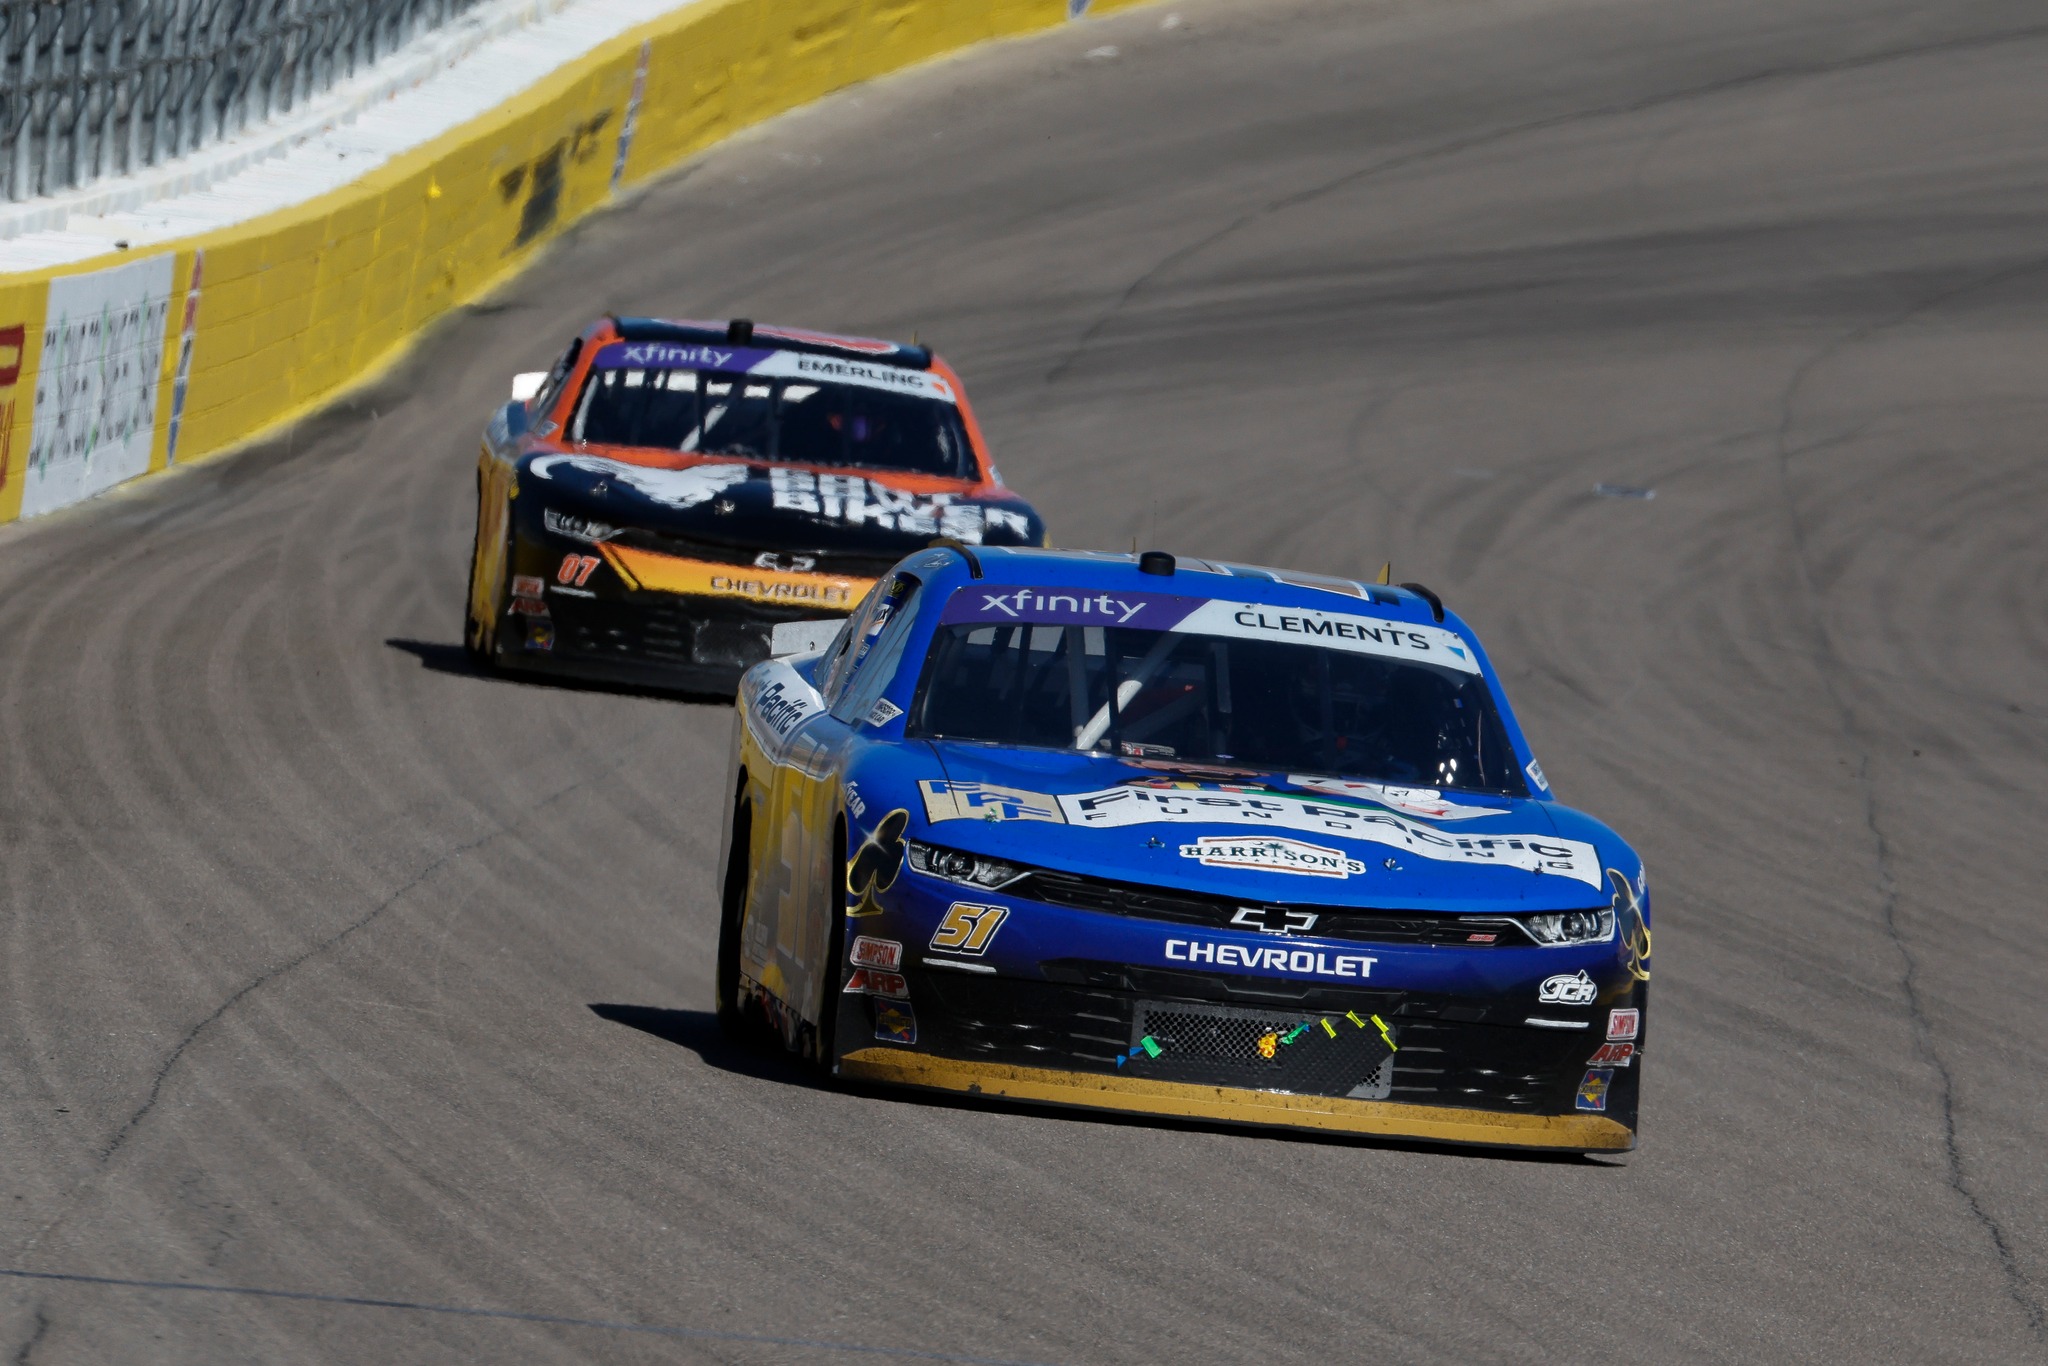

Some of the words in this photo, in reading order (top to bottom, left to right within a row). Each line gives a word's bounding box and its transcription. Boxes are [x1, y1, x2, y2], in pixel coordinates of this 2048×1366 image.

[623, 343, 732, 366] xfinity
[797, 359, 924, 388] EMERLING
[557, 553, 601, 587] 07
[711, 576, 851, 604] CHEVROLET
[980, 589, 1147, 623] xfinity
[1234, 611, 1430, 650] CLEMENTS
[758, 682, 807, 735] Pacific
[1078, 789, 1284, 812] First
[1301, 804, 1574, 858] Pacific
[931, 902, 1009, 955] 51
[858, 941, 897, 967] SIMPSON
[1165, 939, 1378, 978] CHEVROLET
[848, 969, 905, 994] ARP
[1589, 1043, 1633, 1063] ARP
